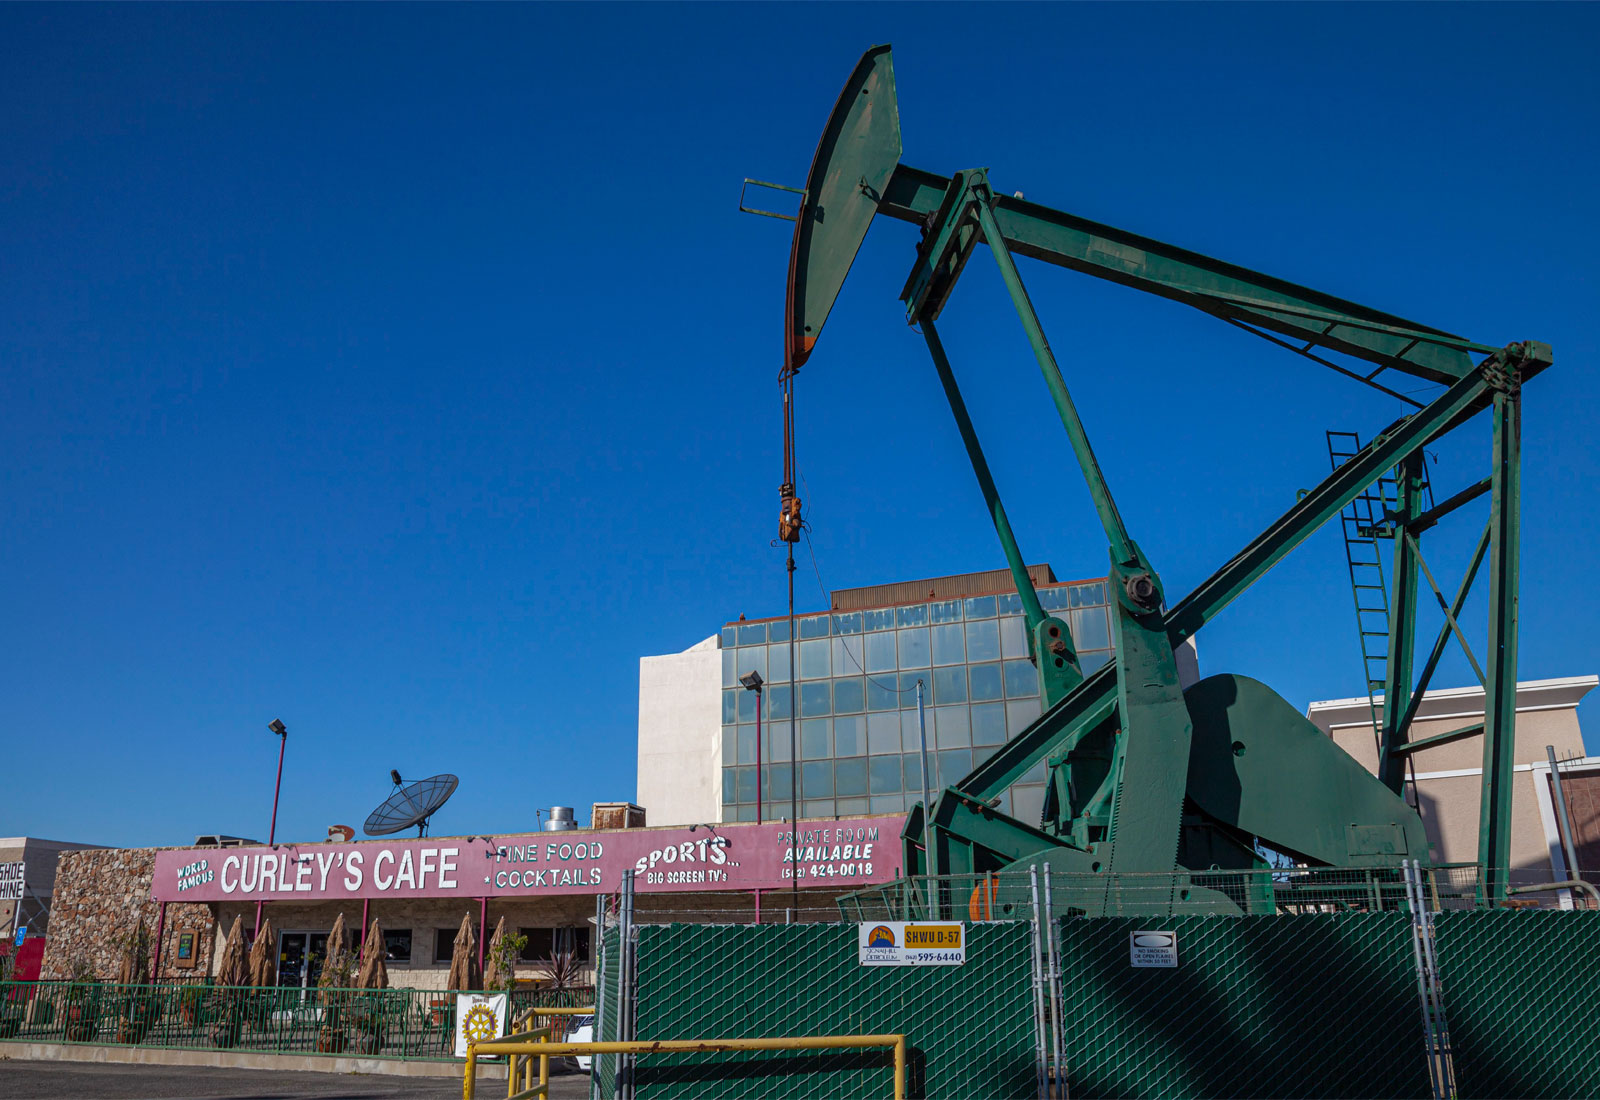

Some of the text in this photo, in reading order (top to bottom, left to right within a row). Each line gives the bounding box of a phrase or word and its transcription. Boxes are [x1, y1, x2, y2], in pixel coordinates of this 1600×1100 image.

[777, 827, 879, 846] PRIVATE ROOM
[496, 842, 603, 863] FINE FOOD
[783, 844, 873, 864] AVAILABLE
[177, 859, 209, 879] WORLD
[220, 848, 459, 893] CURLEY'S CAFE
[495, 867, 602, 888] COCKTAILS
[647, 872, 664, 884] BIG
[667, 870, 705, 884] SCREEN
[810, 862, 873, 878] 424-0018
[0, 881, 23, 898] HINE
[177, 870, 215, 892] FAMOUS
[906, 931, 960, 943] SHWU D-57
[918, 953, 962, 961] 595-6440
